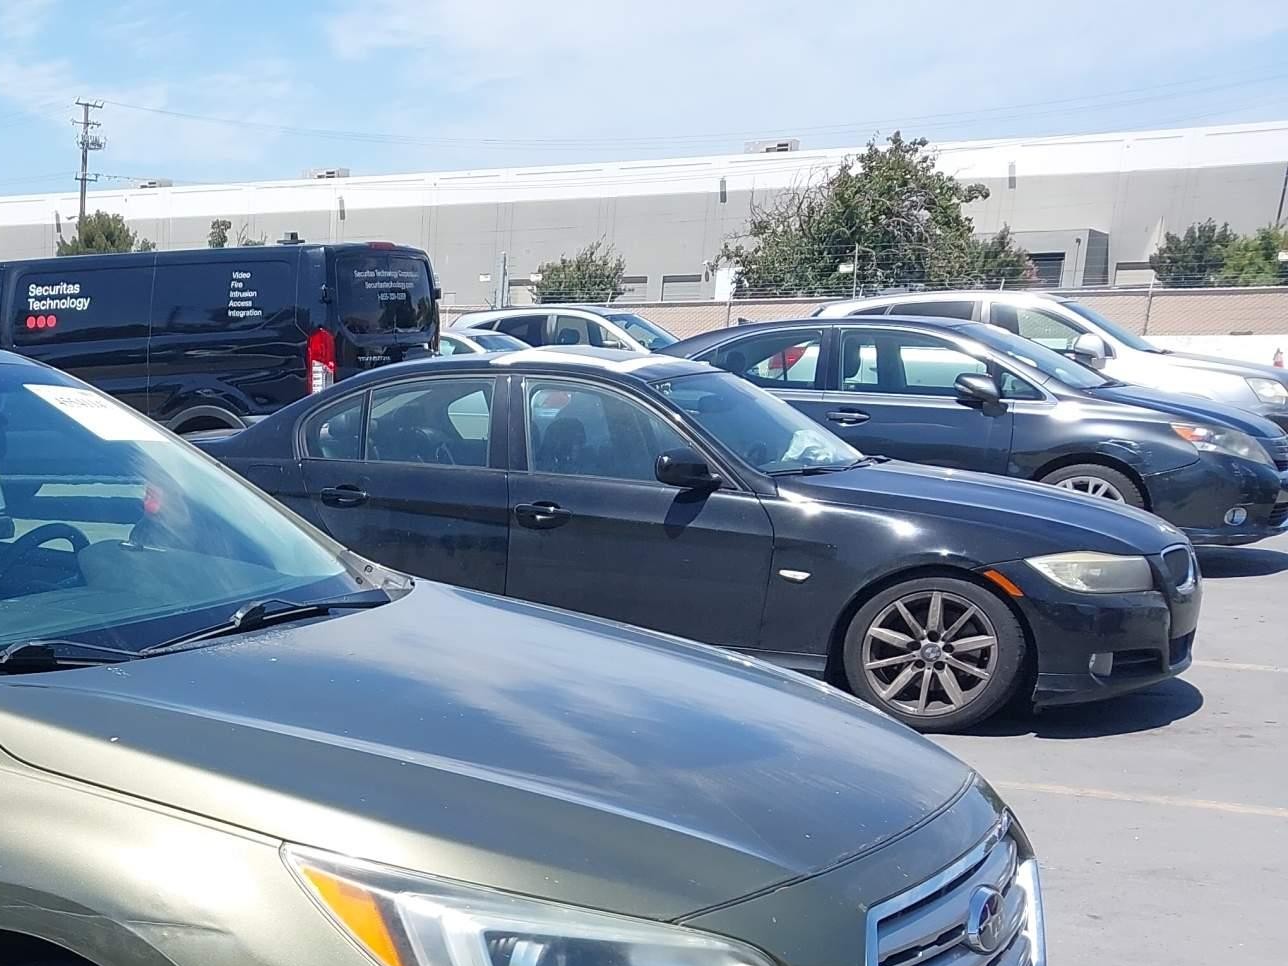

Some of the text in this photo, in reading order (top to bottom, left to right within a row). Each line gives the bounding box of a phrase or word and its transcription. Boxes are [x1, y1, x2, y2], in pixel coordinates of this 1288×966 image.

[232, 271, 251, 279] Video
[230, 280, 243, 289] Fire
[28, 282, 80, 297] Securitas
[229, 290, 258, 298] Intrusion
[27, 296, 90, 311] Technology
[227, 309, 262, 318] Integration
